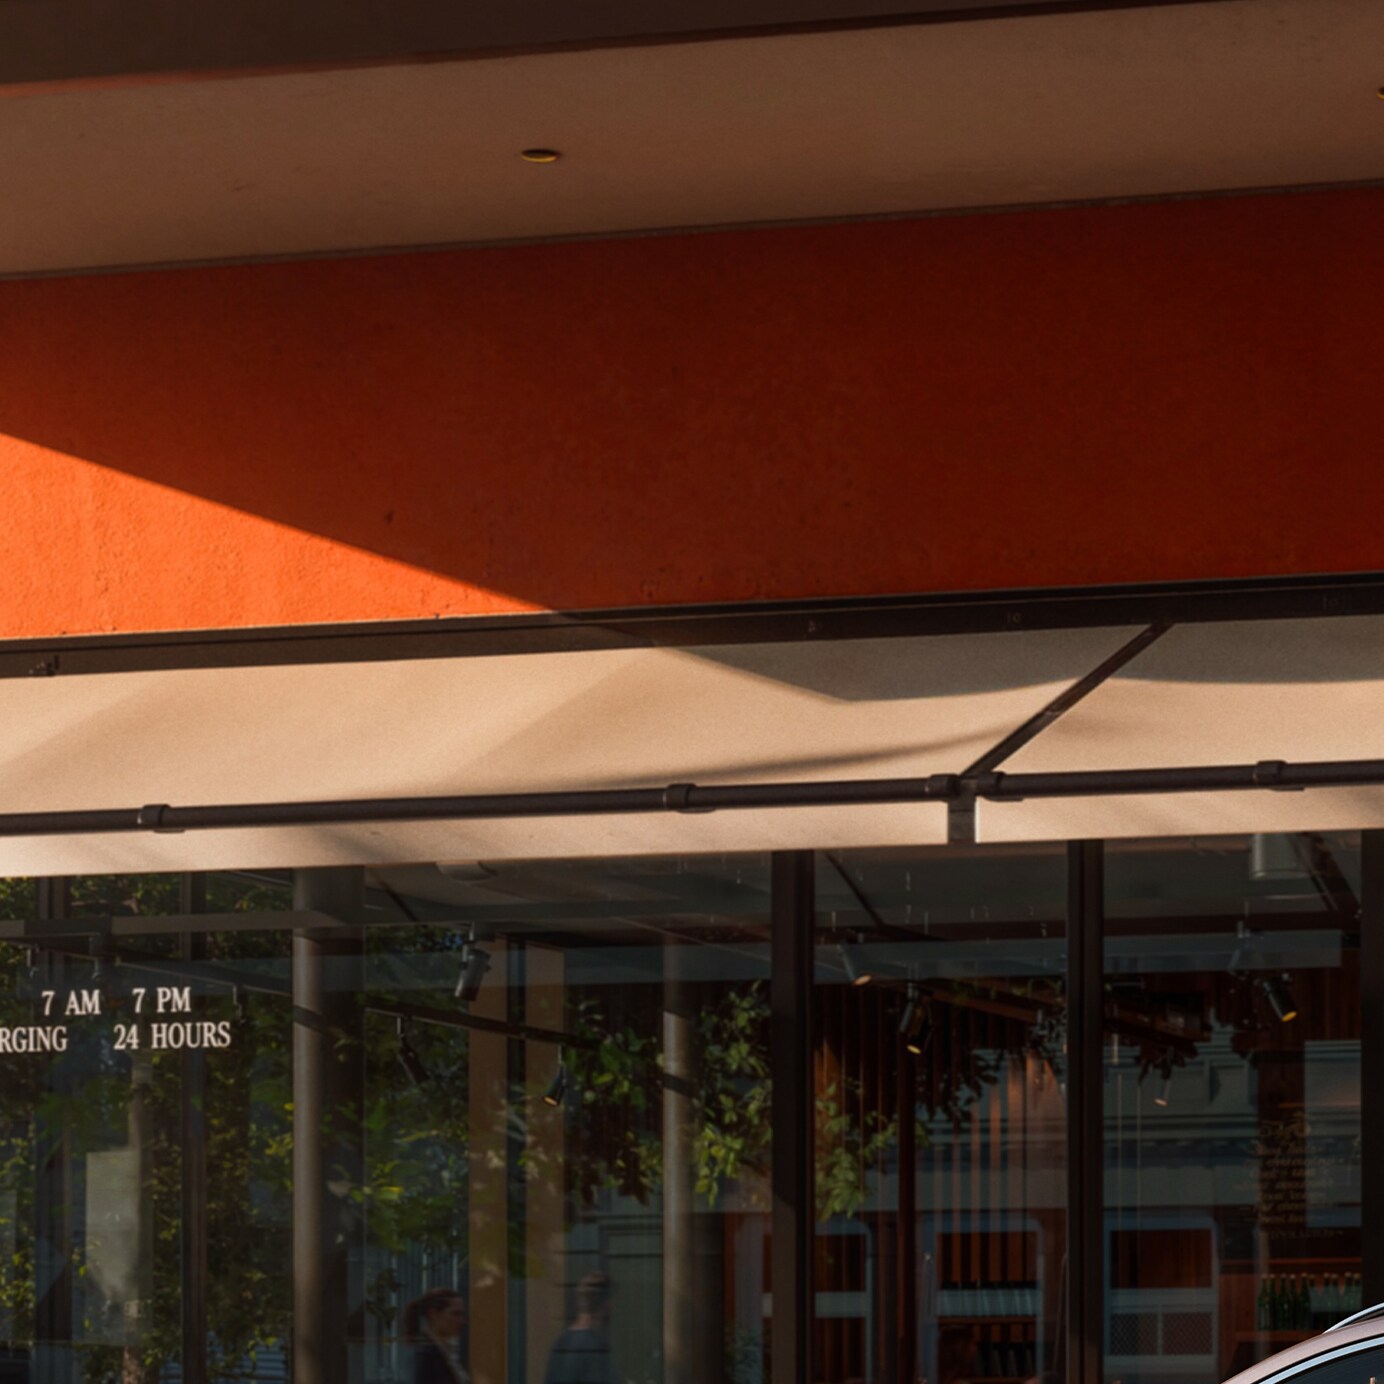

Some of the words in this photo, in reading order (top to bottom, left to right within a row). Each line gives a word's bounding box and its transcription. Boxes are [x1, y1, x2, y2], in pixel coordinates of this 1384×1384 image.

[41, 990, 55, 1016] 7
[64, 988, 101, 1016] AM
[132, 987, 147, 1014] 7
[156, 986, 192, 1013] PM
[0, 1026, 68, 1053] RGING
[113, 1023, 140, 1051] 24
[151, 1020, 232, 1050] HOURS
